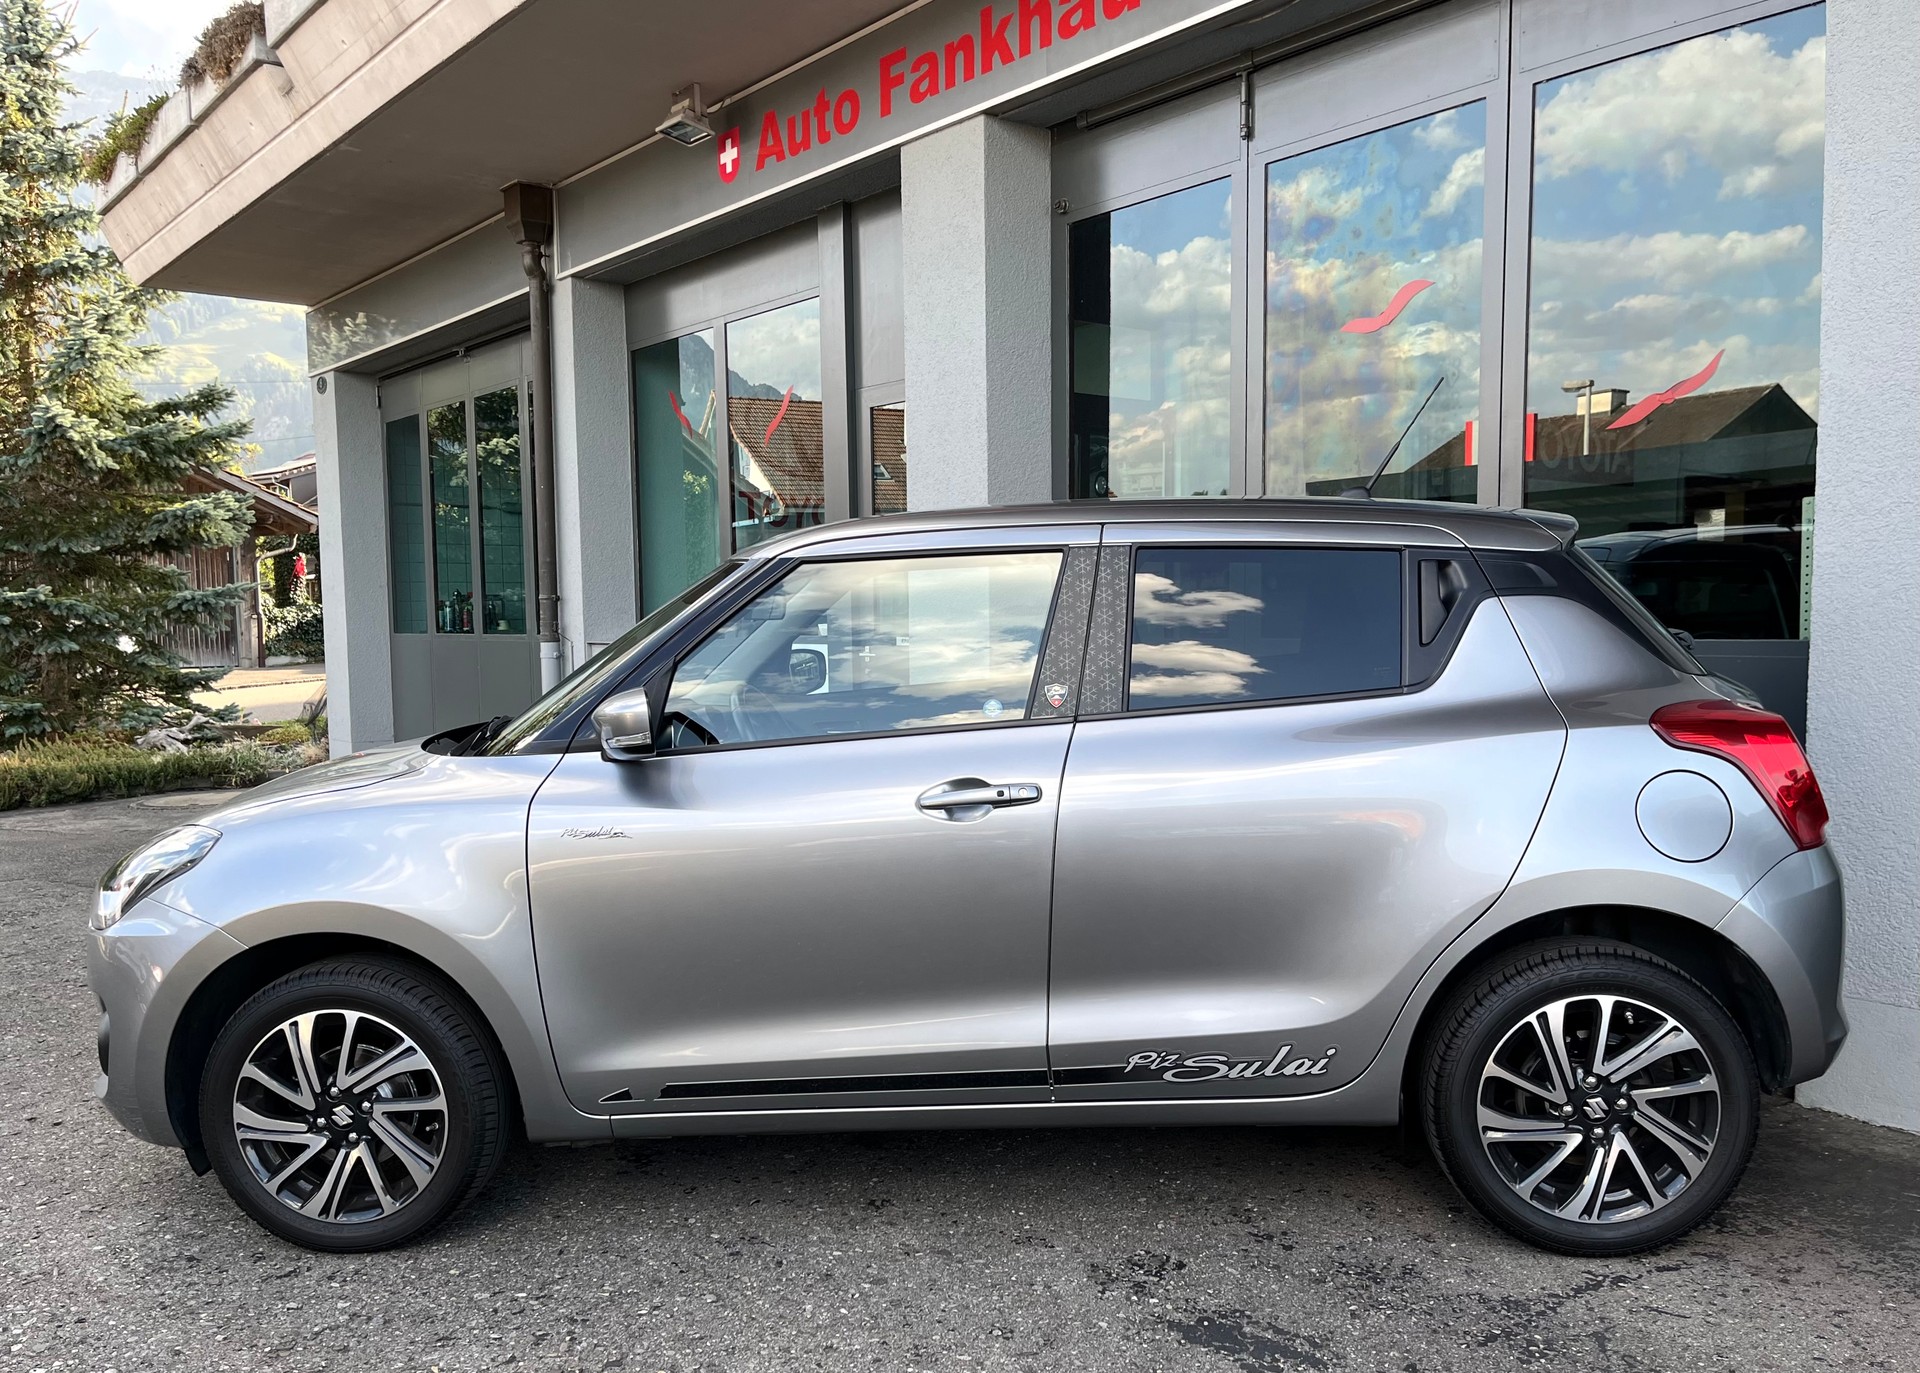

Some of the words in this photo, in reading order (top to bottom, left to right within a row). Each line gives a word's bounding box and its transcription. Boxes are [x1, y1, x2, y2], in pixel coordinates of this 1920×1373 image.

[755, 86, 861, 172] Auto
[1124, 1051, 1181, 1073] Piz
[1162, 1044, 1337, 1083] Sulai
